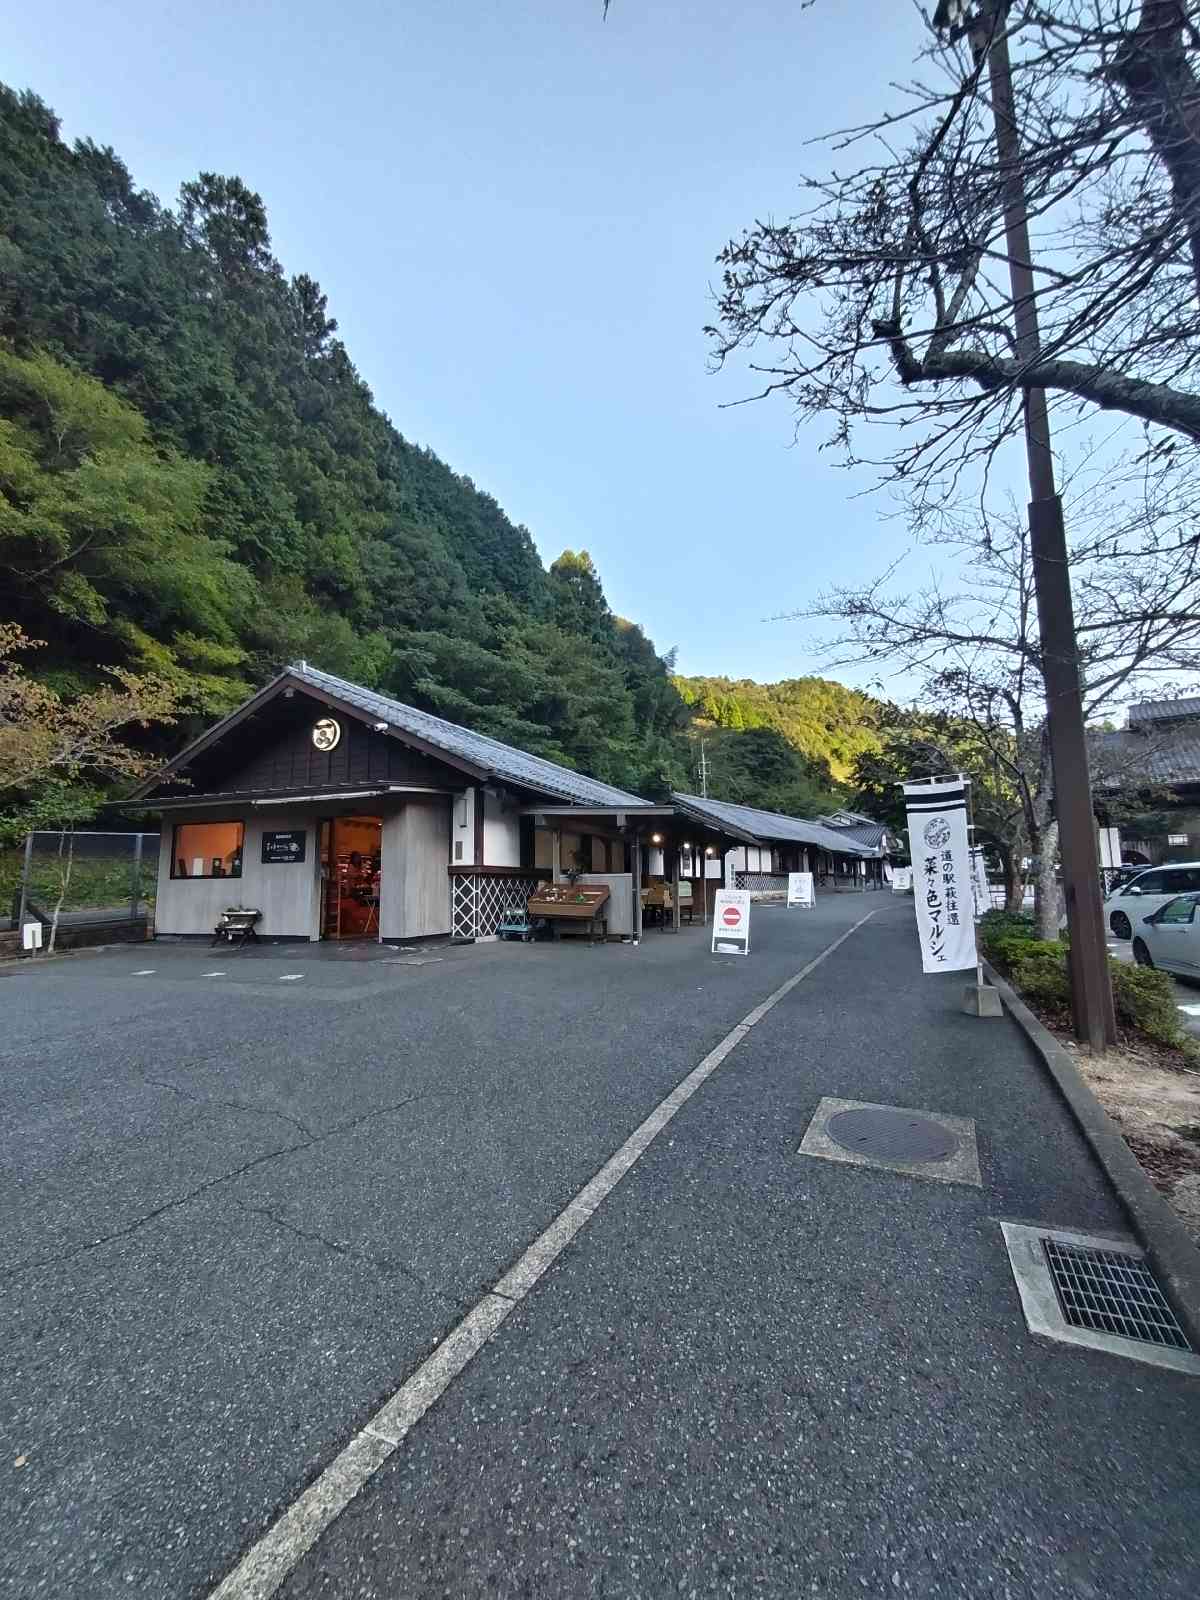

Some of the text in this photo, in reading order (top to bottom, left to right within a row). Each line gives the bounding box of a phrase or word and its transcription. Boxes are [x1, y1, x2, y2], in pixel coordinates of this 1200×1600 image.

[942, 850, 956, 883] 道の駅
[924, 856, 947, 962] 菜々色マルシェ
